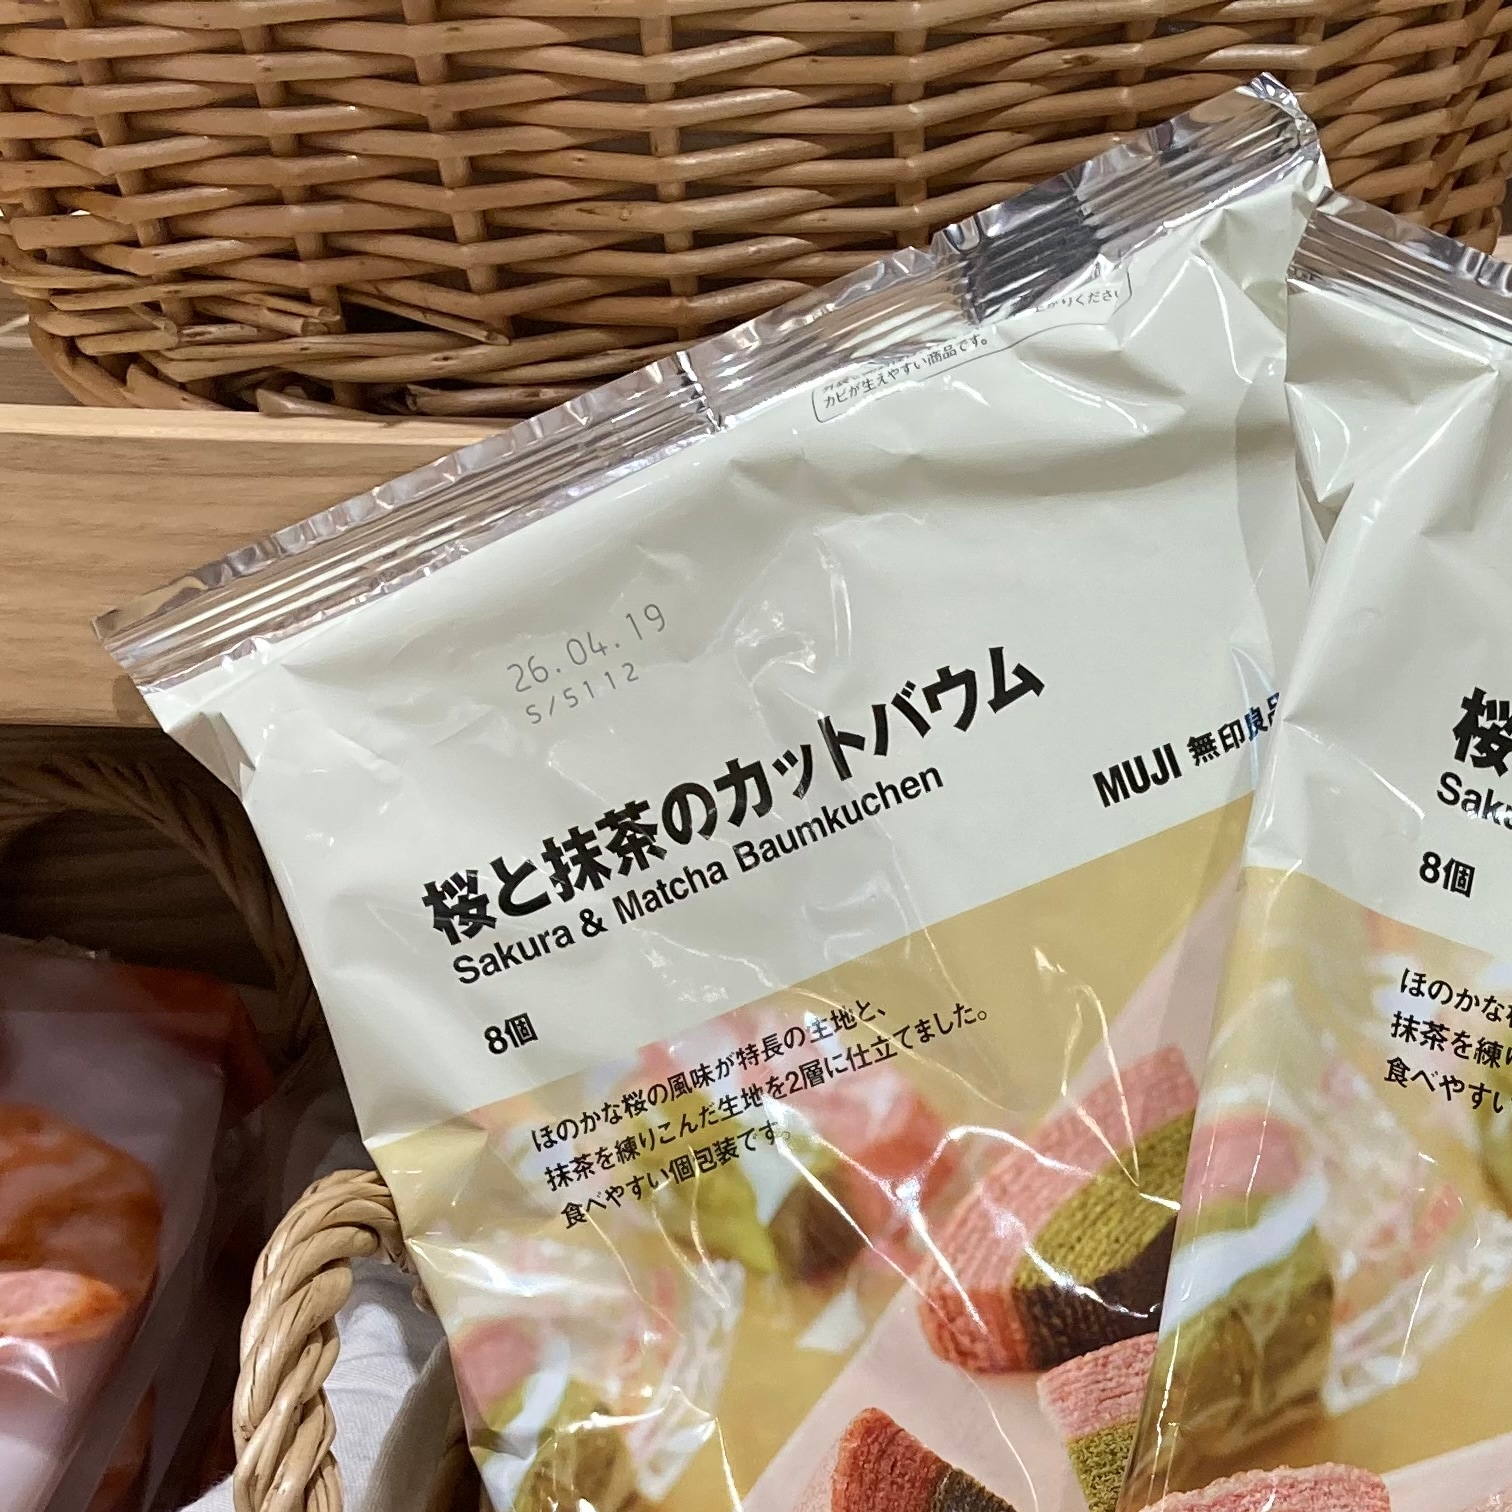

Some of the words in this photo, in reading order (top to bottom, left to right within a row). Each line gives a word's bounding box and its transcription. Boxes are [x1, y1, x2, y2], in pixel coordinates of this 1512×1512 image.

[823, 332, 988, 409] カビが生えやすい商品です。
[506, 603, 665, 692] 26.04.19
[421, 645, 1045, 946] 桜と抹茶のカットバウム
[1092, 742, 1183, 808] MUJI
[452, 922, 576, 985] Sakura
[580, 907, 609, 939] &
[611, 856, 729, 926] Matcha
[731, 766, 945, 873] Baumkuchen
[1418, 850, 1476, 898] 8個
[482, 1011, 539, 1055] 8個
[530, 999, 887, 1153] ほのかな桜の風味が特長の生地と、
[544, 1002, 988, 1194] 抹茶を練りこんだ生地を2層に仕立てました。
[560, 1118, 791, 1230] 食べやすい個包装です。
